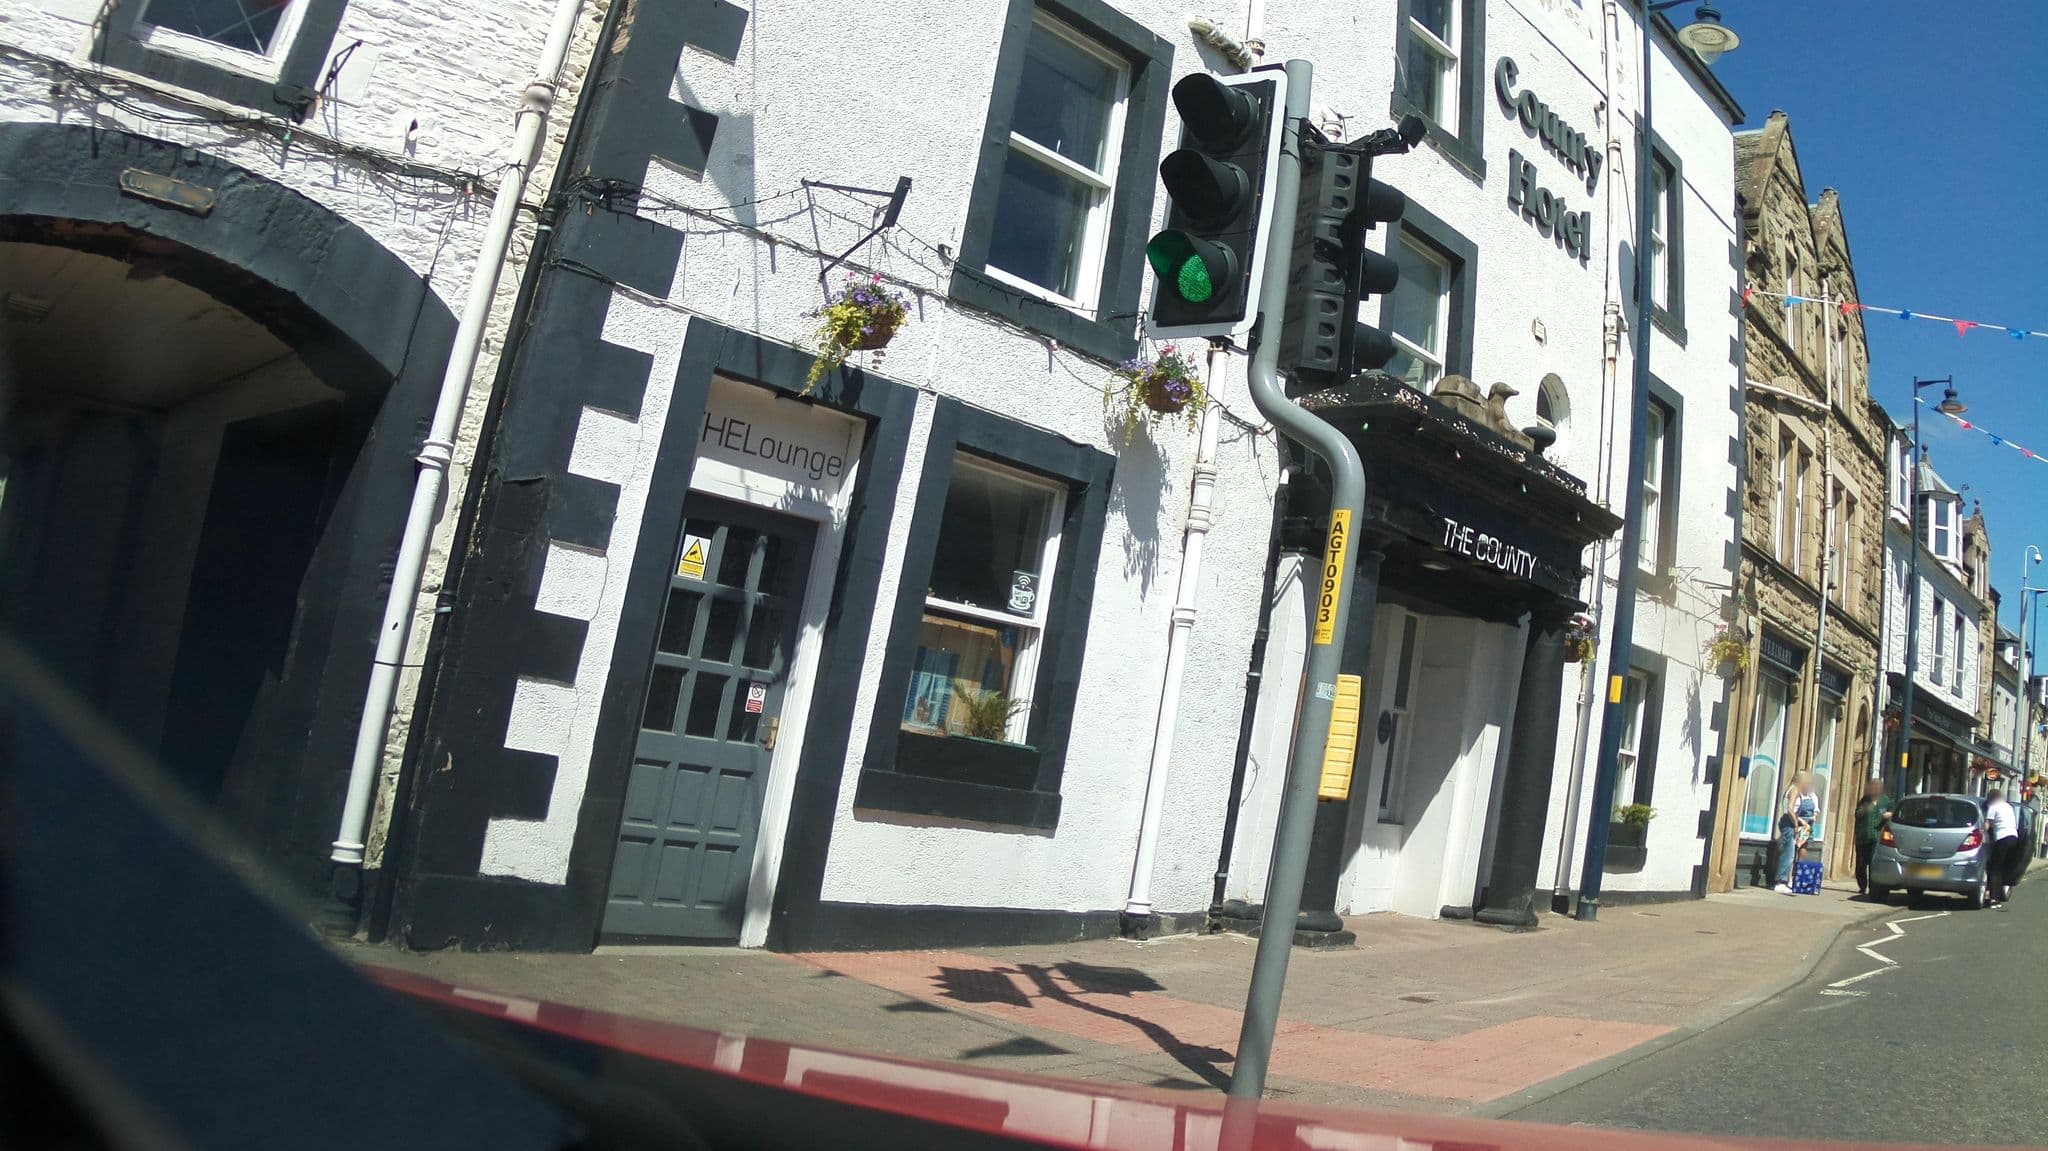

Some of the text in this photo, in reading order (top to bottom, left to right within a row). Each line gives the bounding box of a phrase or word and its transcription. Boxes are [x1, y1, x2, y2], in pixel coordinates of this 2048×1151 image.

[1495, 56, 1603, 196] County
[1508, 147, 1591, 263] Hotel
[702, 411, 842, 481] HELounge
[1319, 521, 1344, 622] AGT0903
[1444, 517, 1537, 580] THE COUNTY
